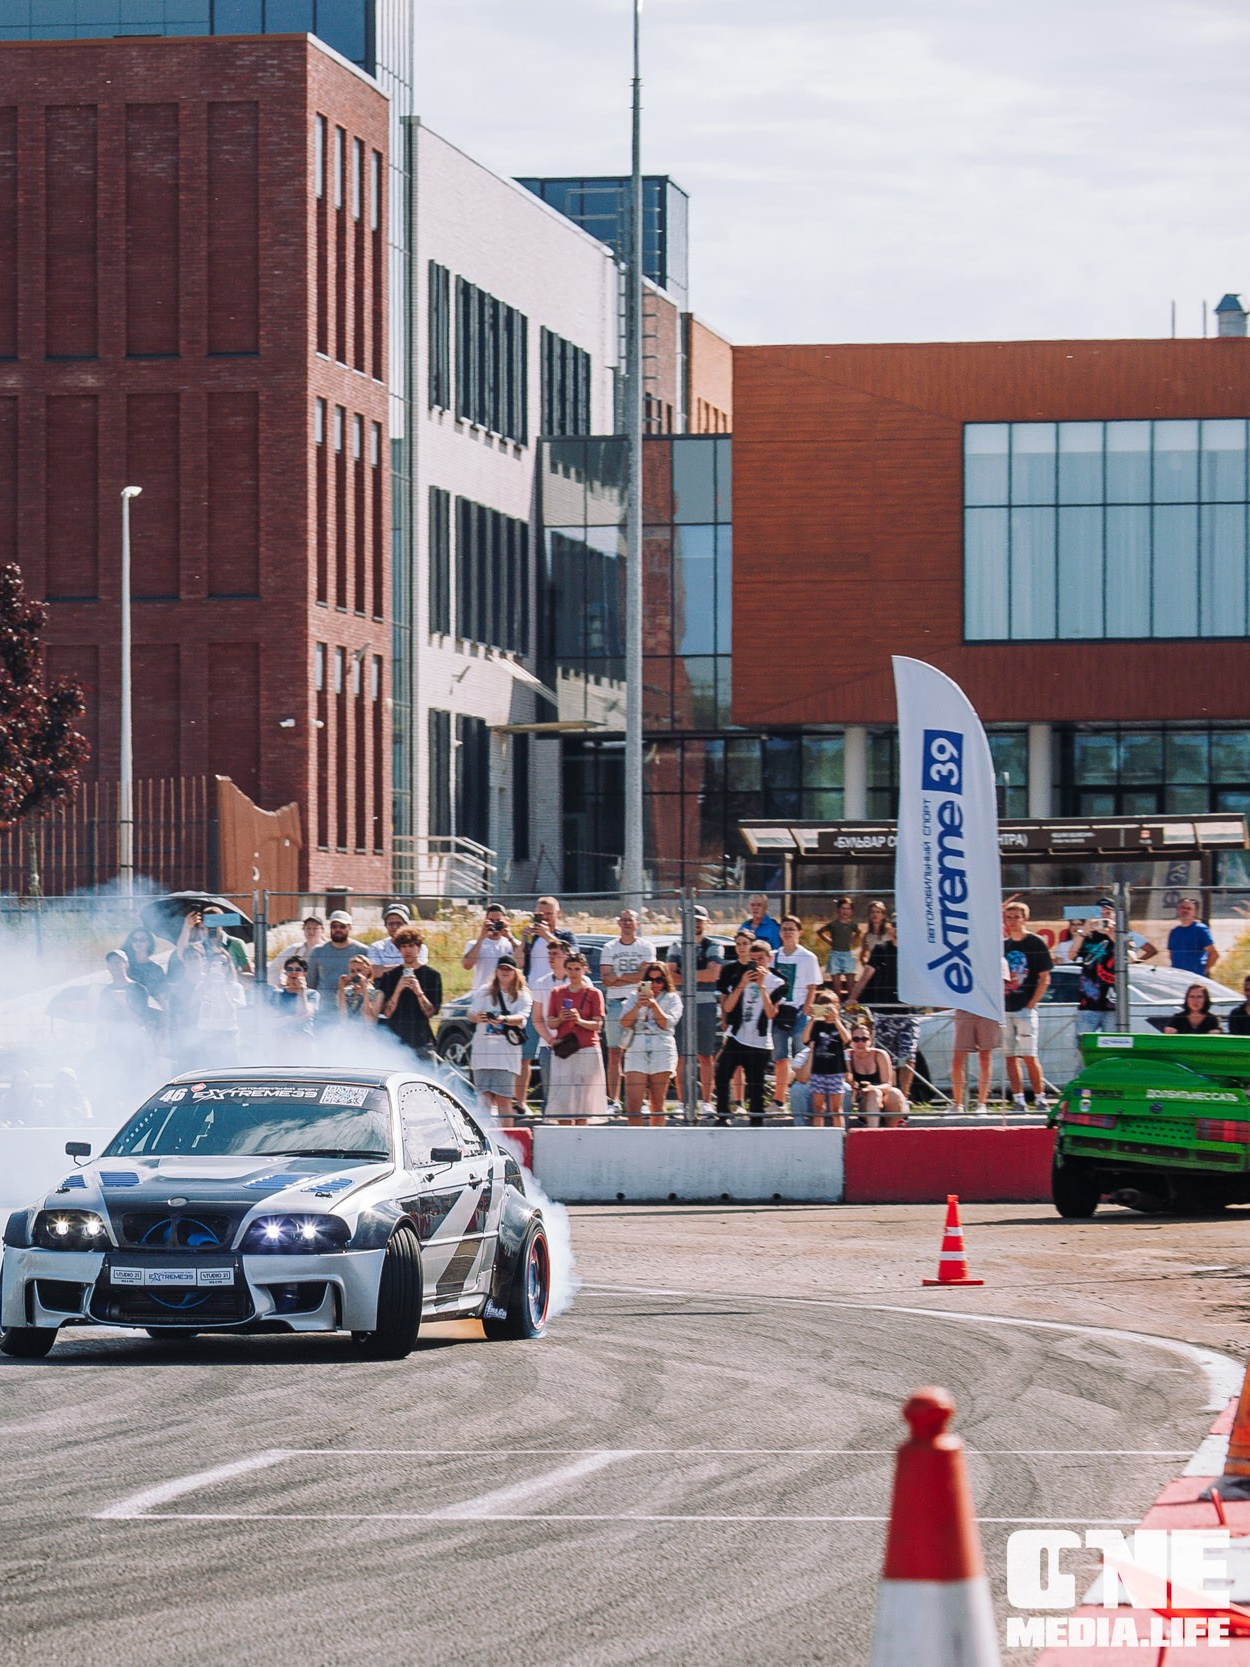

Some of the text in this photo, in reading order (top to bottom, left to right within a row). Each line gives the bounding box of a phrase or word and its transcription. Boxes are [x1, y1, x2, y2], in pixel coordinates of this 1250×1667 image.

[929, 737, 960, 786] 39
[922, 798, 932, 836] СПОРТ
[159, 1088, 188, 1102] 46
[192, 1086, 318, 1103] EXTREME39
